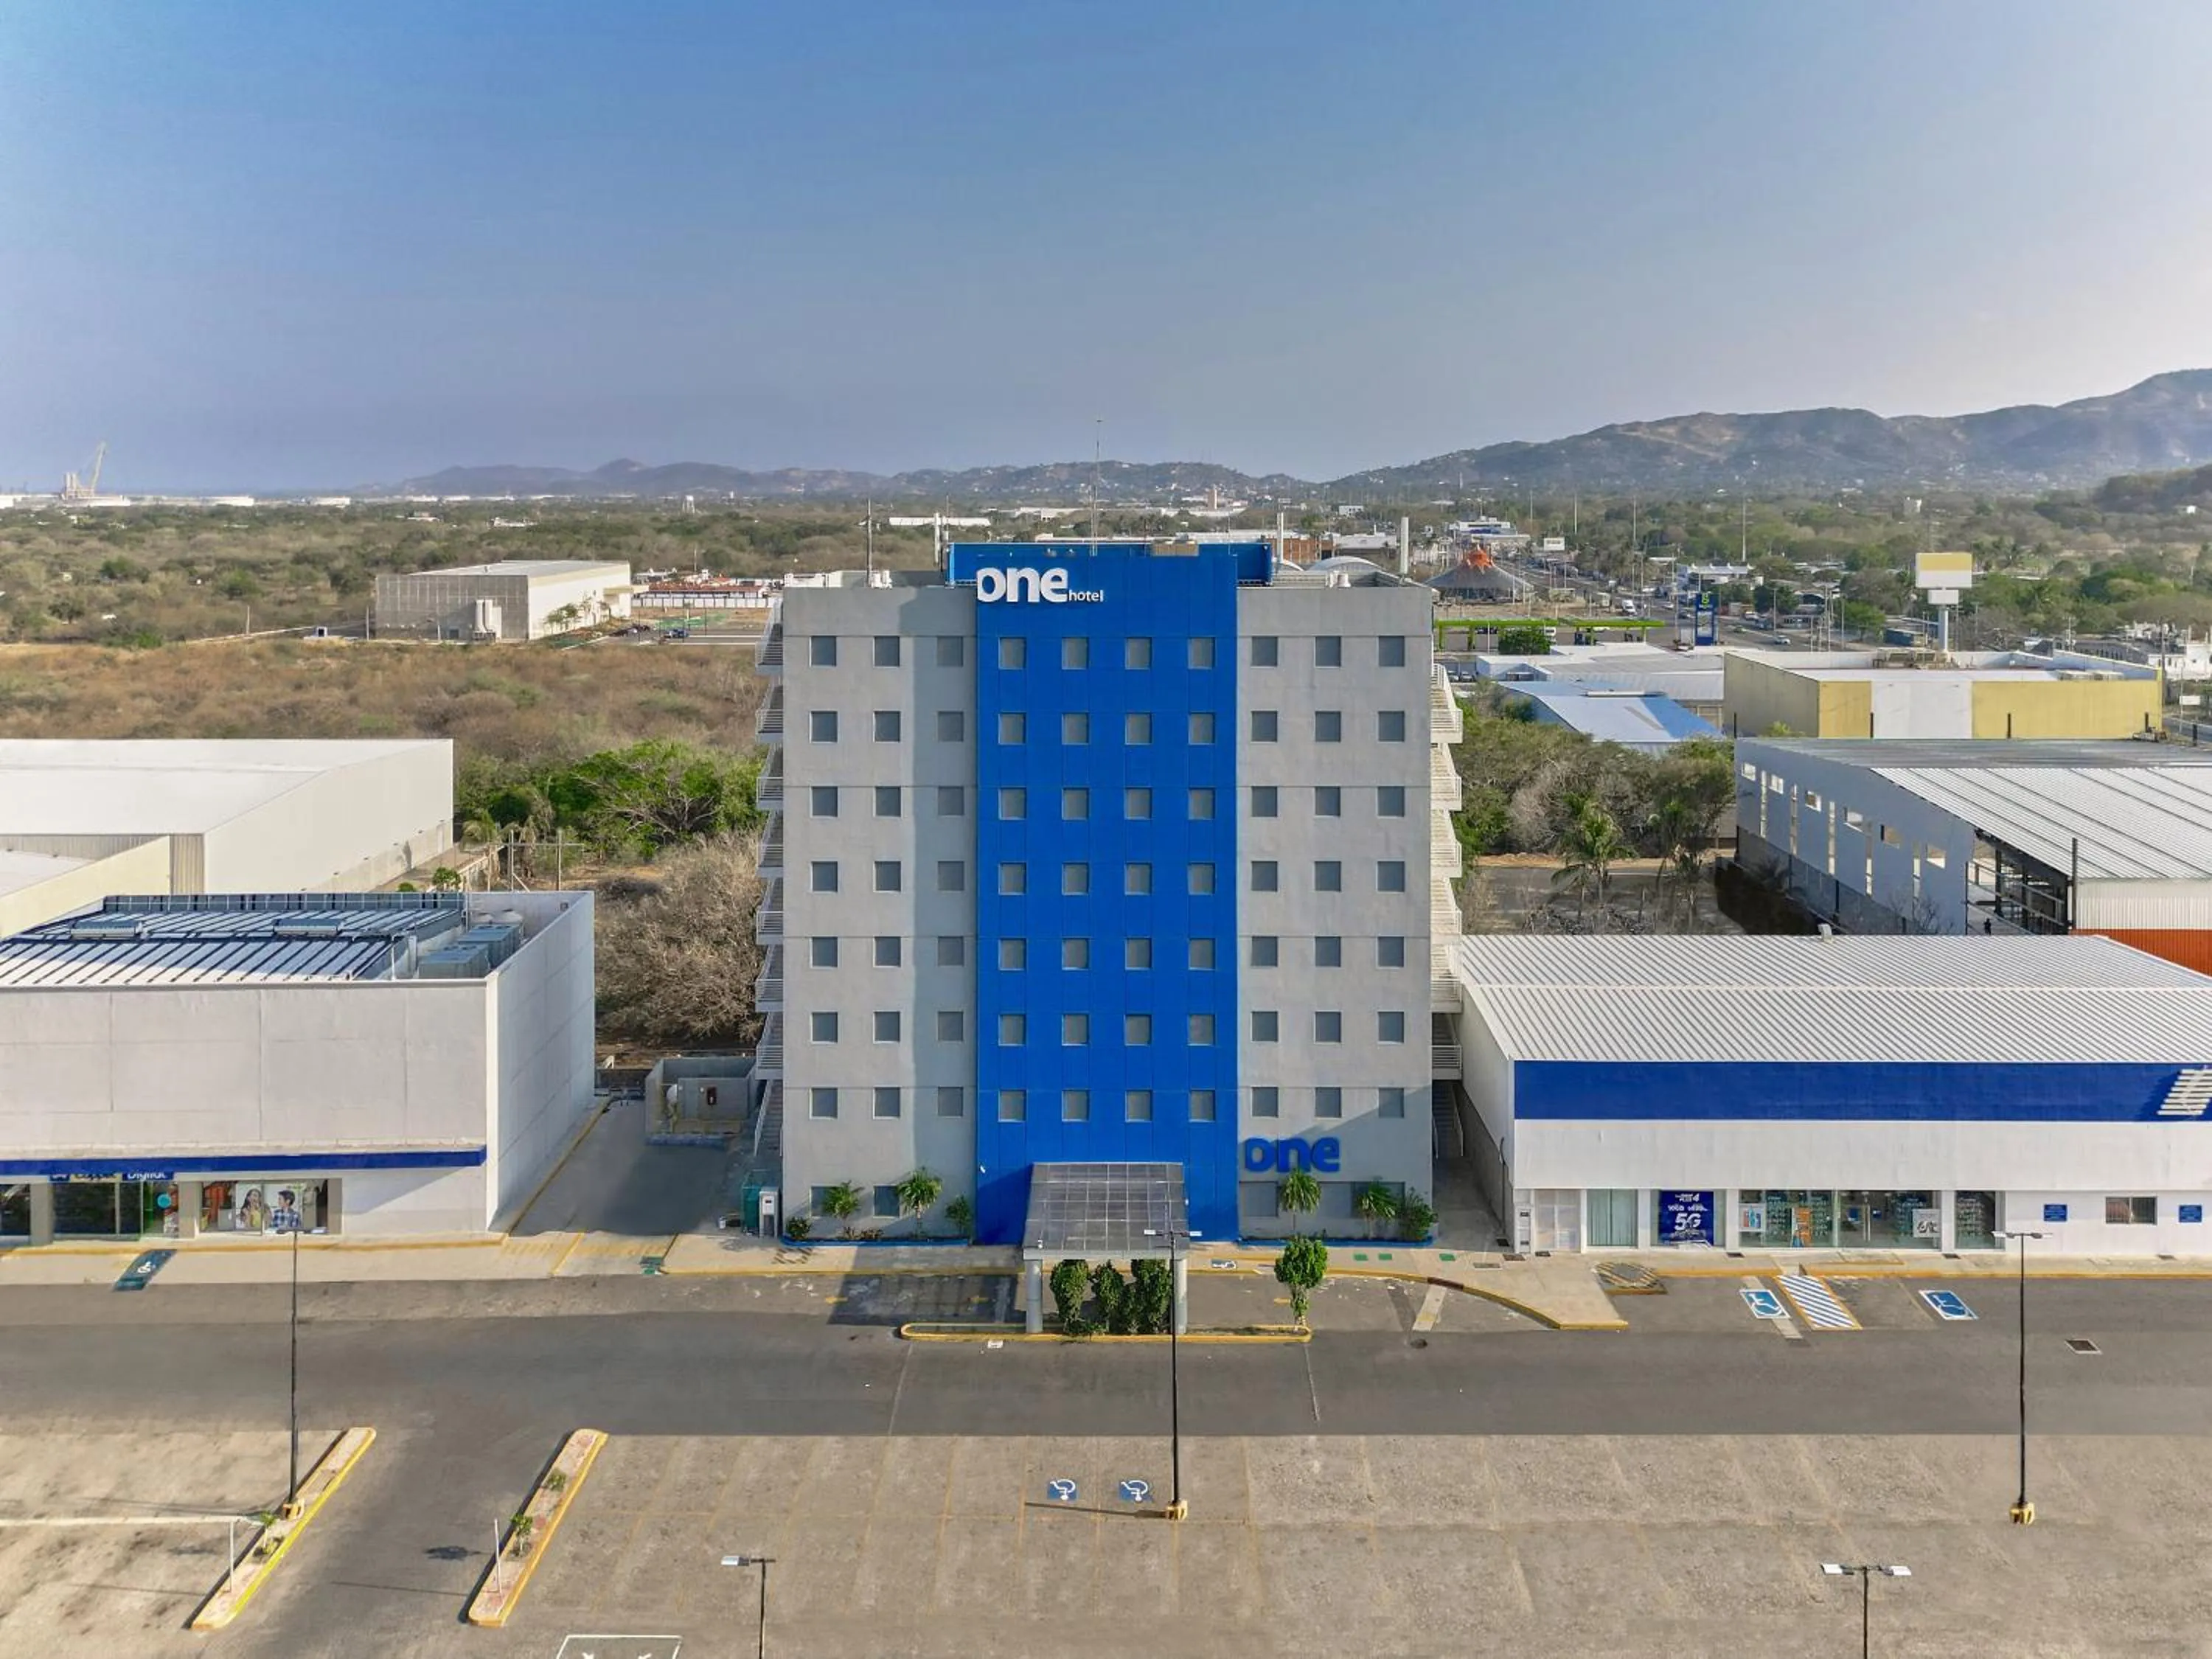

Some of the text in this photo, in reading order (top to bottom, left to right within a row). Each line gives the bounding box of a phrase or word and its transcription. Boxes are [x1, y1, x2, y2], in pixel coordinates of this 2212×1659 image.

[977, 567, 1104, 602] one hotel
[1245, 1137, 1340, 1173] one
[1674, 1212, 1702, 1231] 5G
